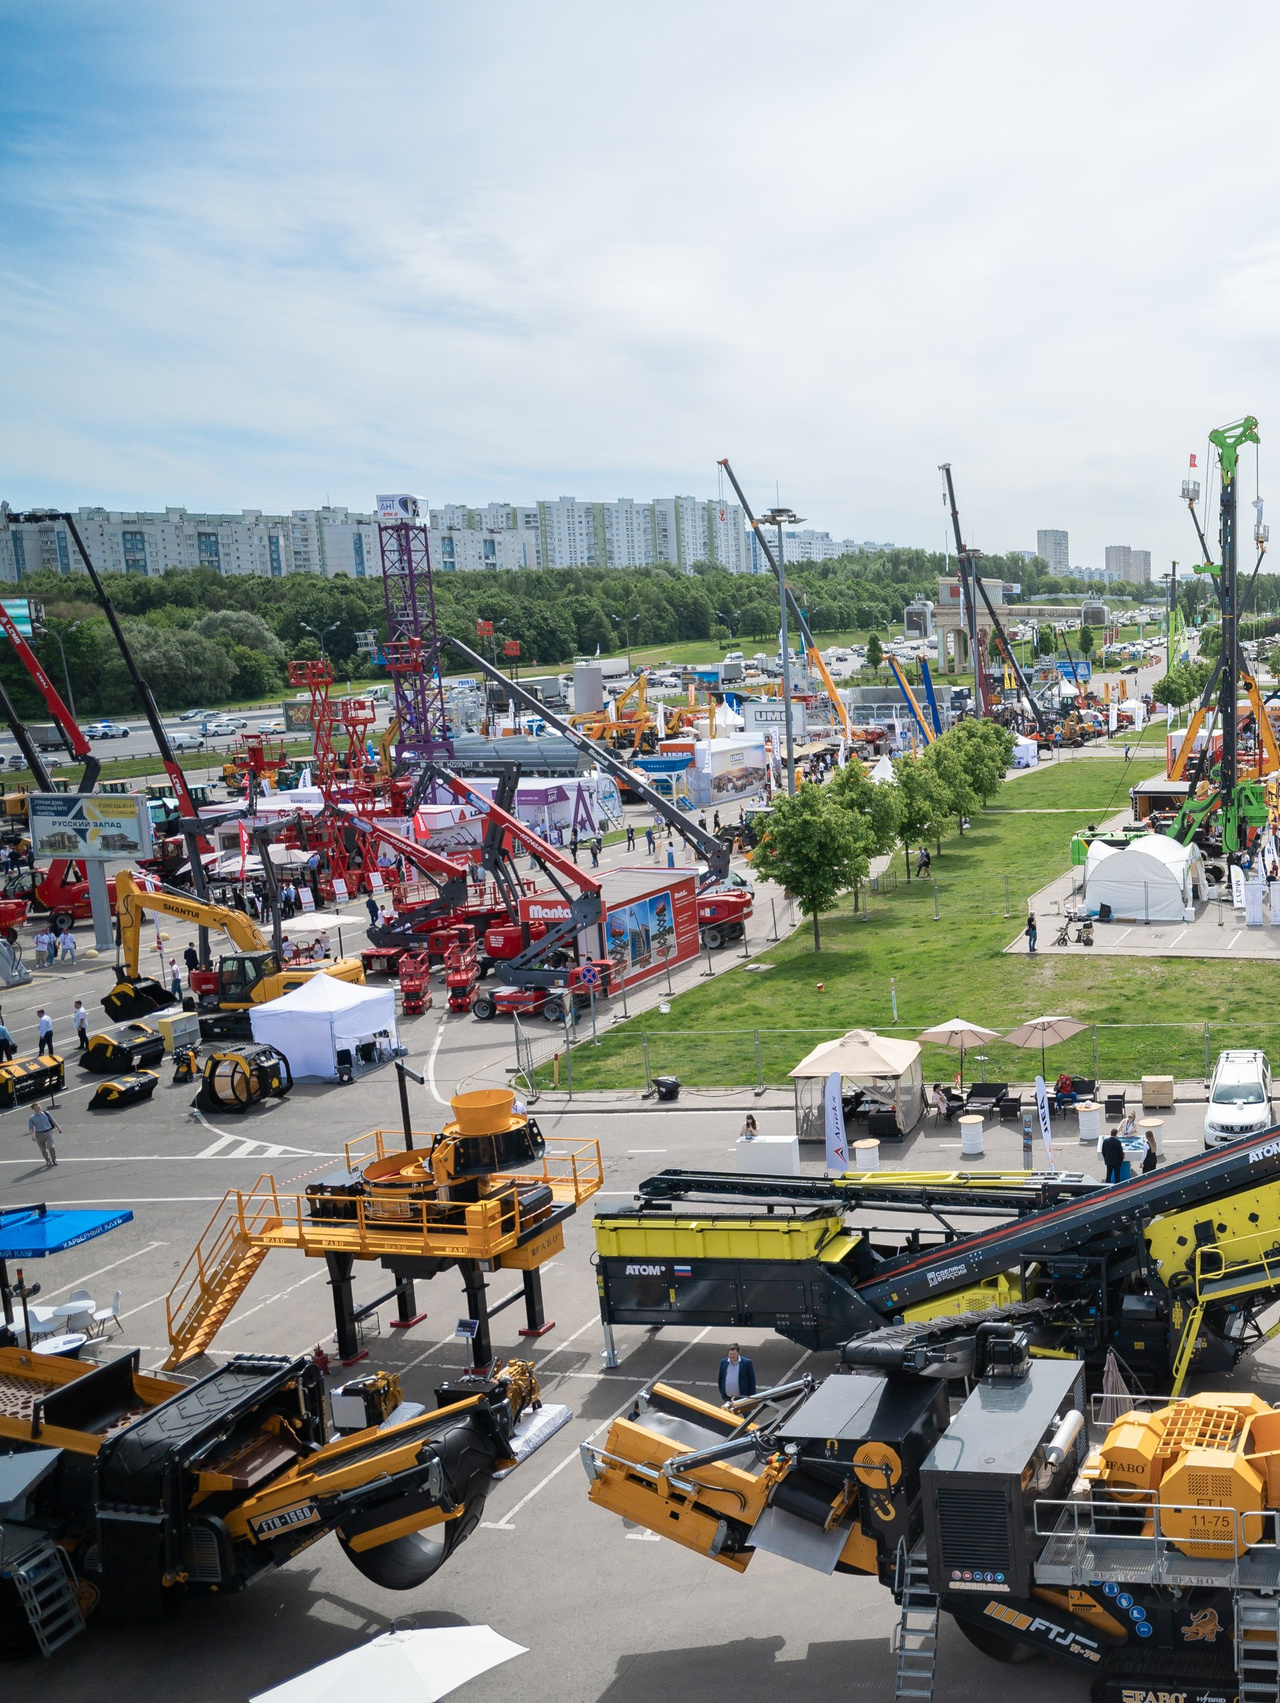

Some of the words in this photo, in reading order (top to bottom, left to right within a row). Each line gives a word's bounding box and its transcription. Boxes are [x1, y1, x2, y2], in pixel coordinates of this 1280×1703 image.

[52, 820, 91, 829] РУССКИЙ
[93, 821, 122, 829] ЗАПАД
[163, 903, 200, 919] SHANTUI
[62, 1226, 103, 1249] КАРЬЕРНЫЙ
[104, 1217, 123, 1232] КЛУБ
[531, 1233, 560, 1257] FABO
[625, 1264, 661, 1276] ATOM
[935, 1263, 966, 1277] СДЕЛАНО
[1106, 1460, 1147, 1475] FABO
[261, 1507, 312, 1532] FTB-1550
[1191, 1514, 1230, 1528] 11-75
[1093, 1571, 1138, 1582] FABO
[1172, 1576, 1218, 1586] FABO
[1029, 1617, 1077, 1646] FTJ
[1069, 1643, 1101, 1662] 11-75
